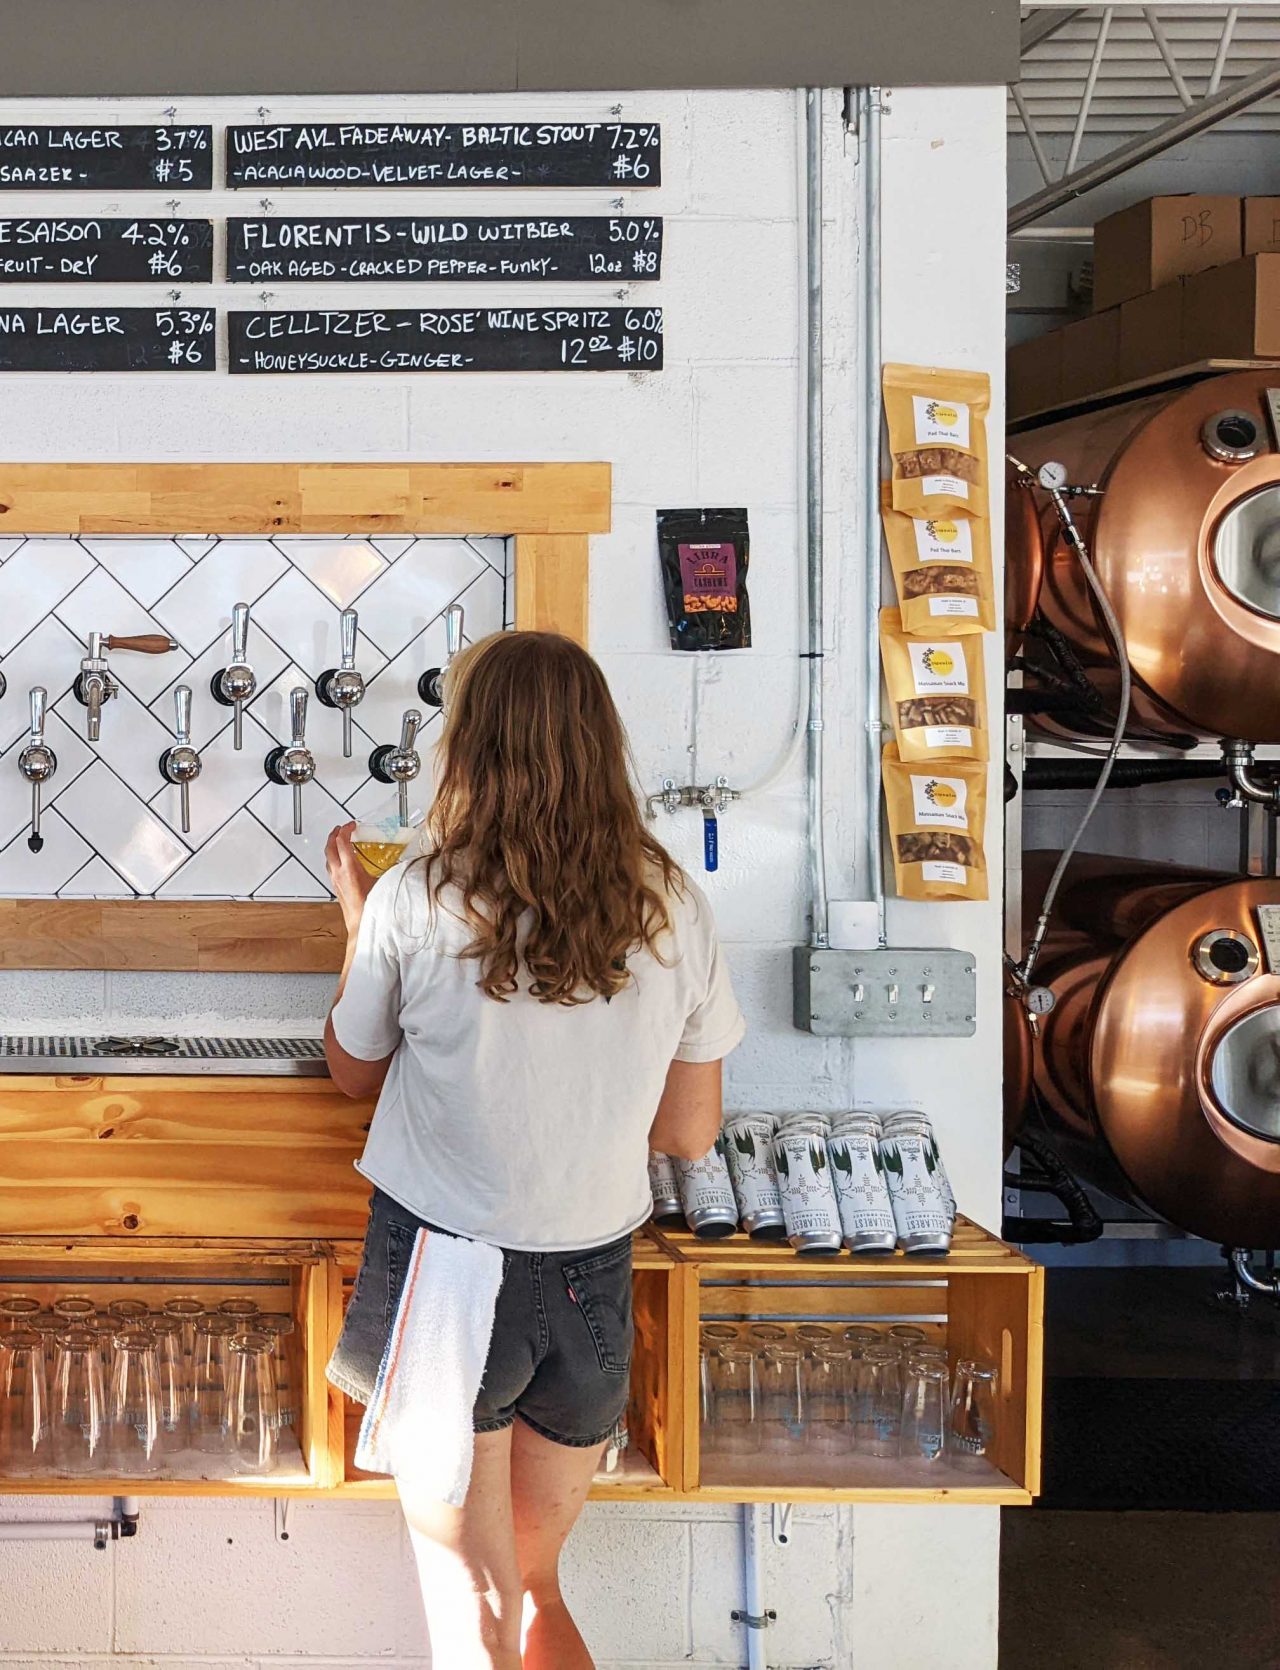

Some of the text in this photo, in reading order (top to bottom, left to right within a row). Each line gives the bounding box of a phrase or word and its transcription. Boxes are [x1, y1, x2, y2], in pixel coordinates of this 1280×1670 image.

[48, 129, 123, 151] LAGER
[155, 128, 207, 151] 3.7%
[233, 127, 292, 154] WEST
[294, 127, 336, 151] AVL
[461, 125, 533, 148] BALTIC
[536, 123, 602, 145] STOUT
[606, 124, 660, 150] 7.2%
[0, 166, 73, 182] SAAZER
[612, 154, 650, 179] $6
[121, 222, 190, 247] 4.2%
[478, 221, 575, 242] WITBIER
[609, 219, 660, 242] 5.0%
[60, 254, 99, 276] DRY
[147, 249, 183, 277] $6
[632, 249, 657, 273] $8
[36, 312, 125, 335] LAGER
[155, 310, 214, 337] 5.3%
[487, 310, 540, 332] WINE
[541, 310, 611, 331] SPRITZ
[624, 307, 663, 336] 6.0%
[167, 339, 202, 365] $6
[616, 335, 658, 363] $10
